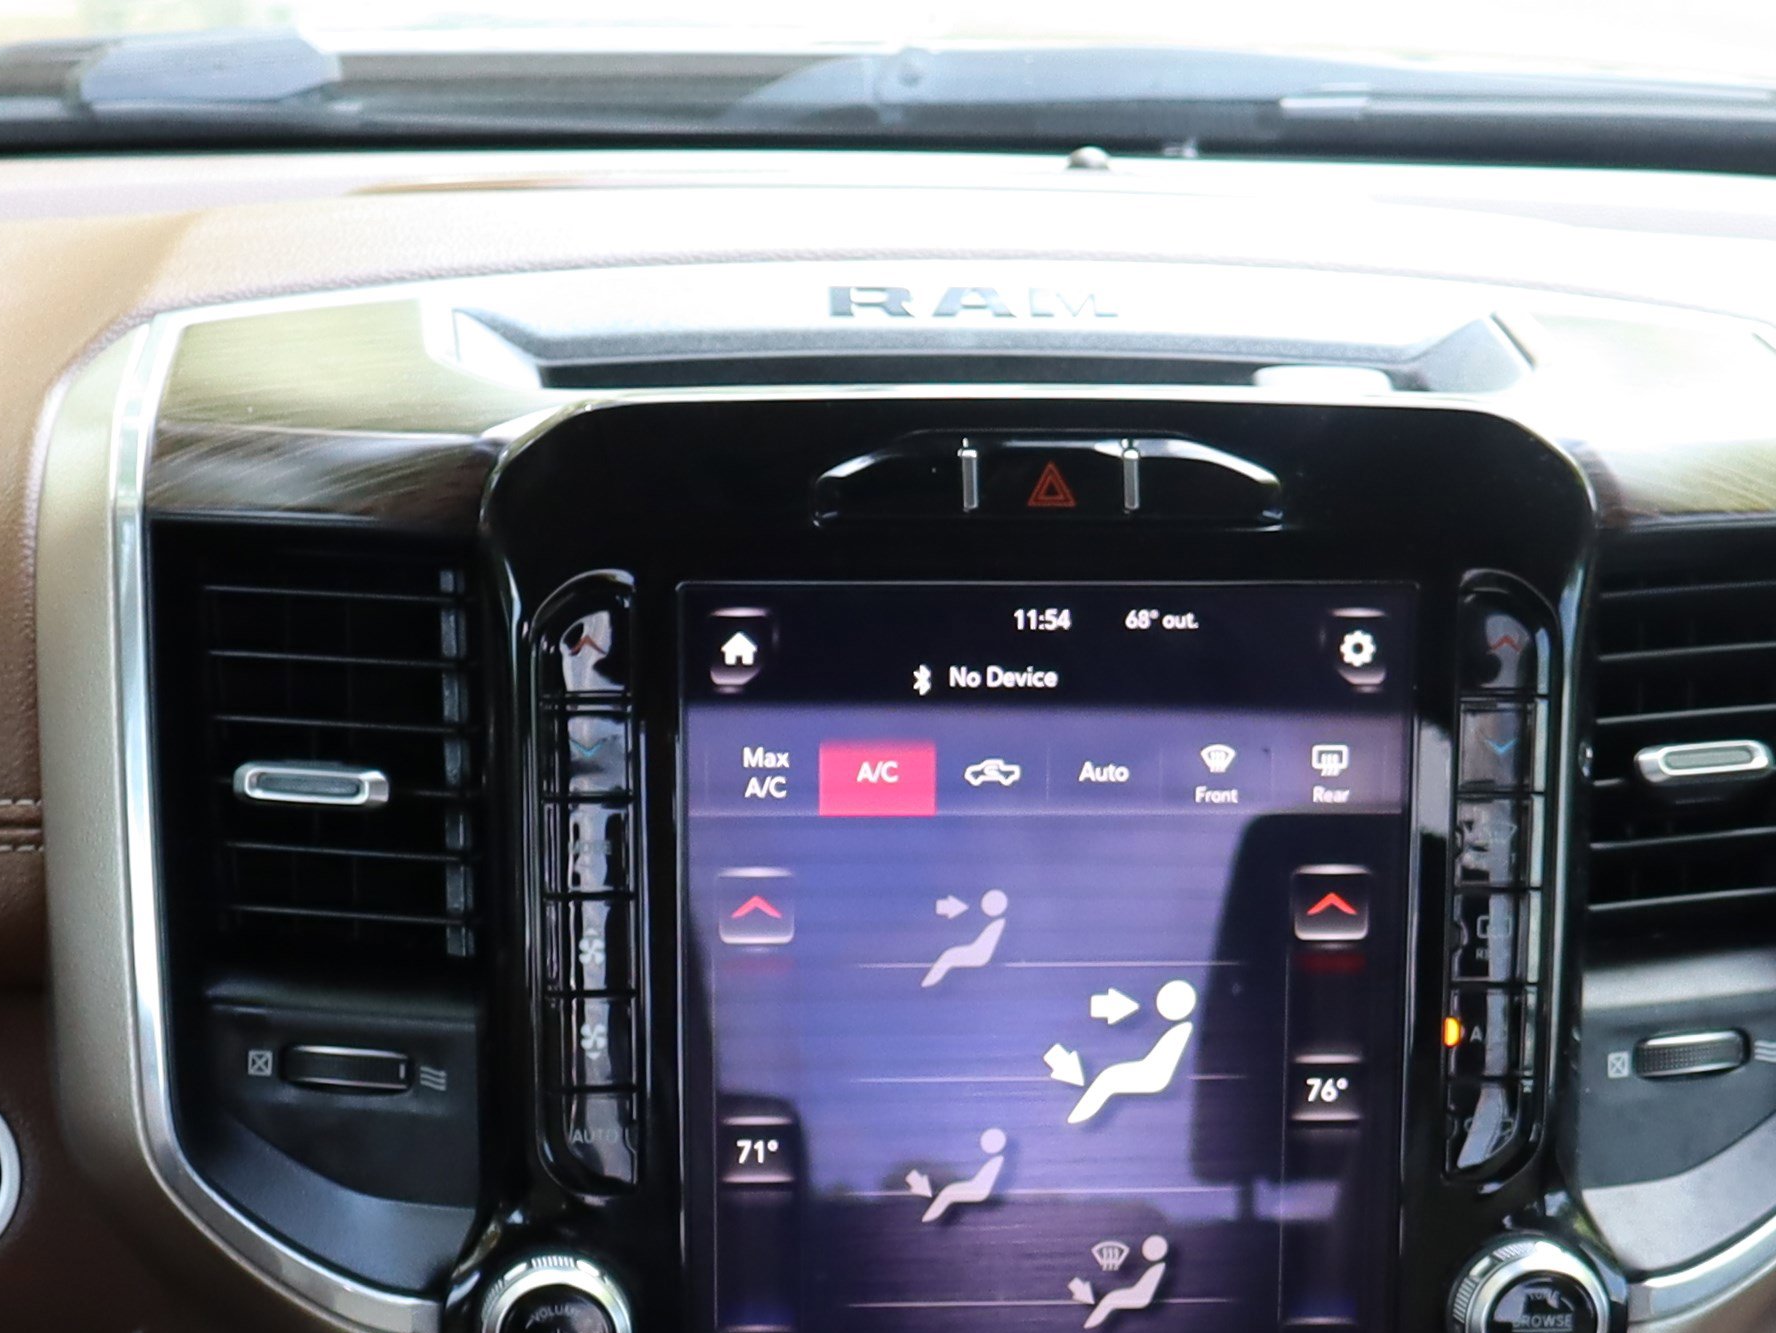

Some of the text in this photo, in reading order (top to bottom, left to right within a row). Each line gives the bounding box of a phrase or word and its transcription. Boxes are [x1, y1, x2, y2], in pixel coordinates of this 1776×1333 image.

[828, 285, 1118, 318] RAM
[1013, 609, 1072, 632] 11:54
[1125, 609, 1199, 631] 68° out.
[949, 665, 1059, 690] No Device
[742, 748, 791, 769] Max
[856, 761, 899, 784] A/C
[1078, 761, 1131, 783] Auto
[744, 777, 788, 800] A/C
[1195, 786, 1240, 805] Front
[1312, 785, 1351, 805] Rear
[1306, 1077, 1349, 1103] 76°
[572, 1129, 619, 1144] AUTO
[736, 1138, 779, 1165] 71°
[1512, 1313, 1573, 1328] BROWSE
